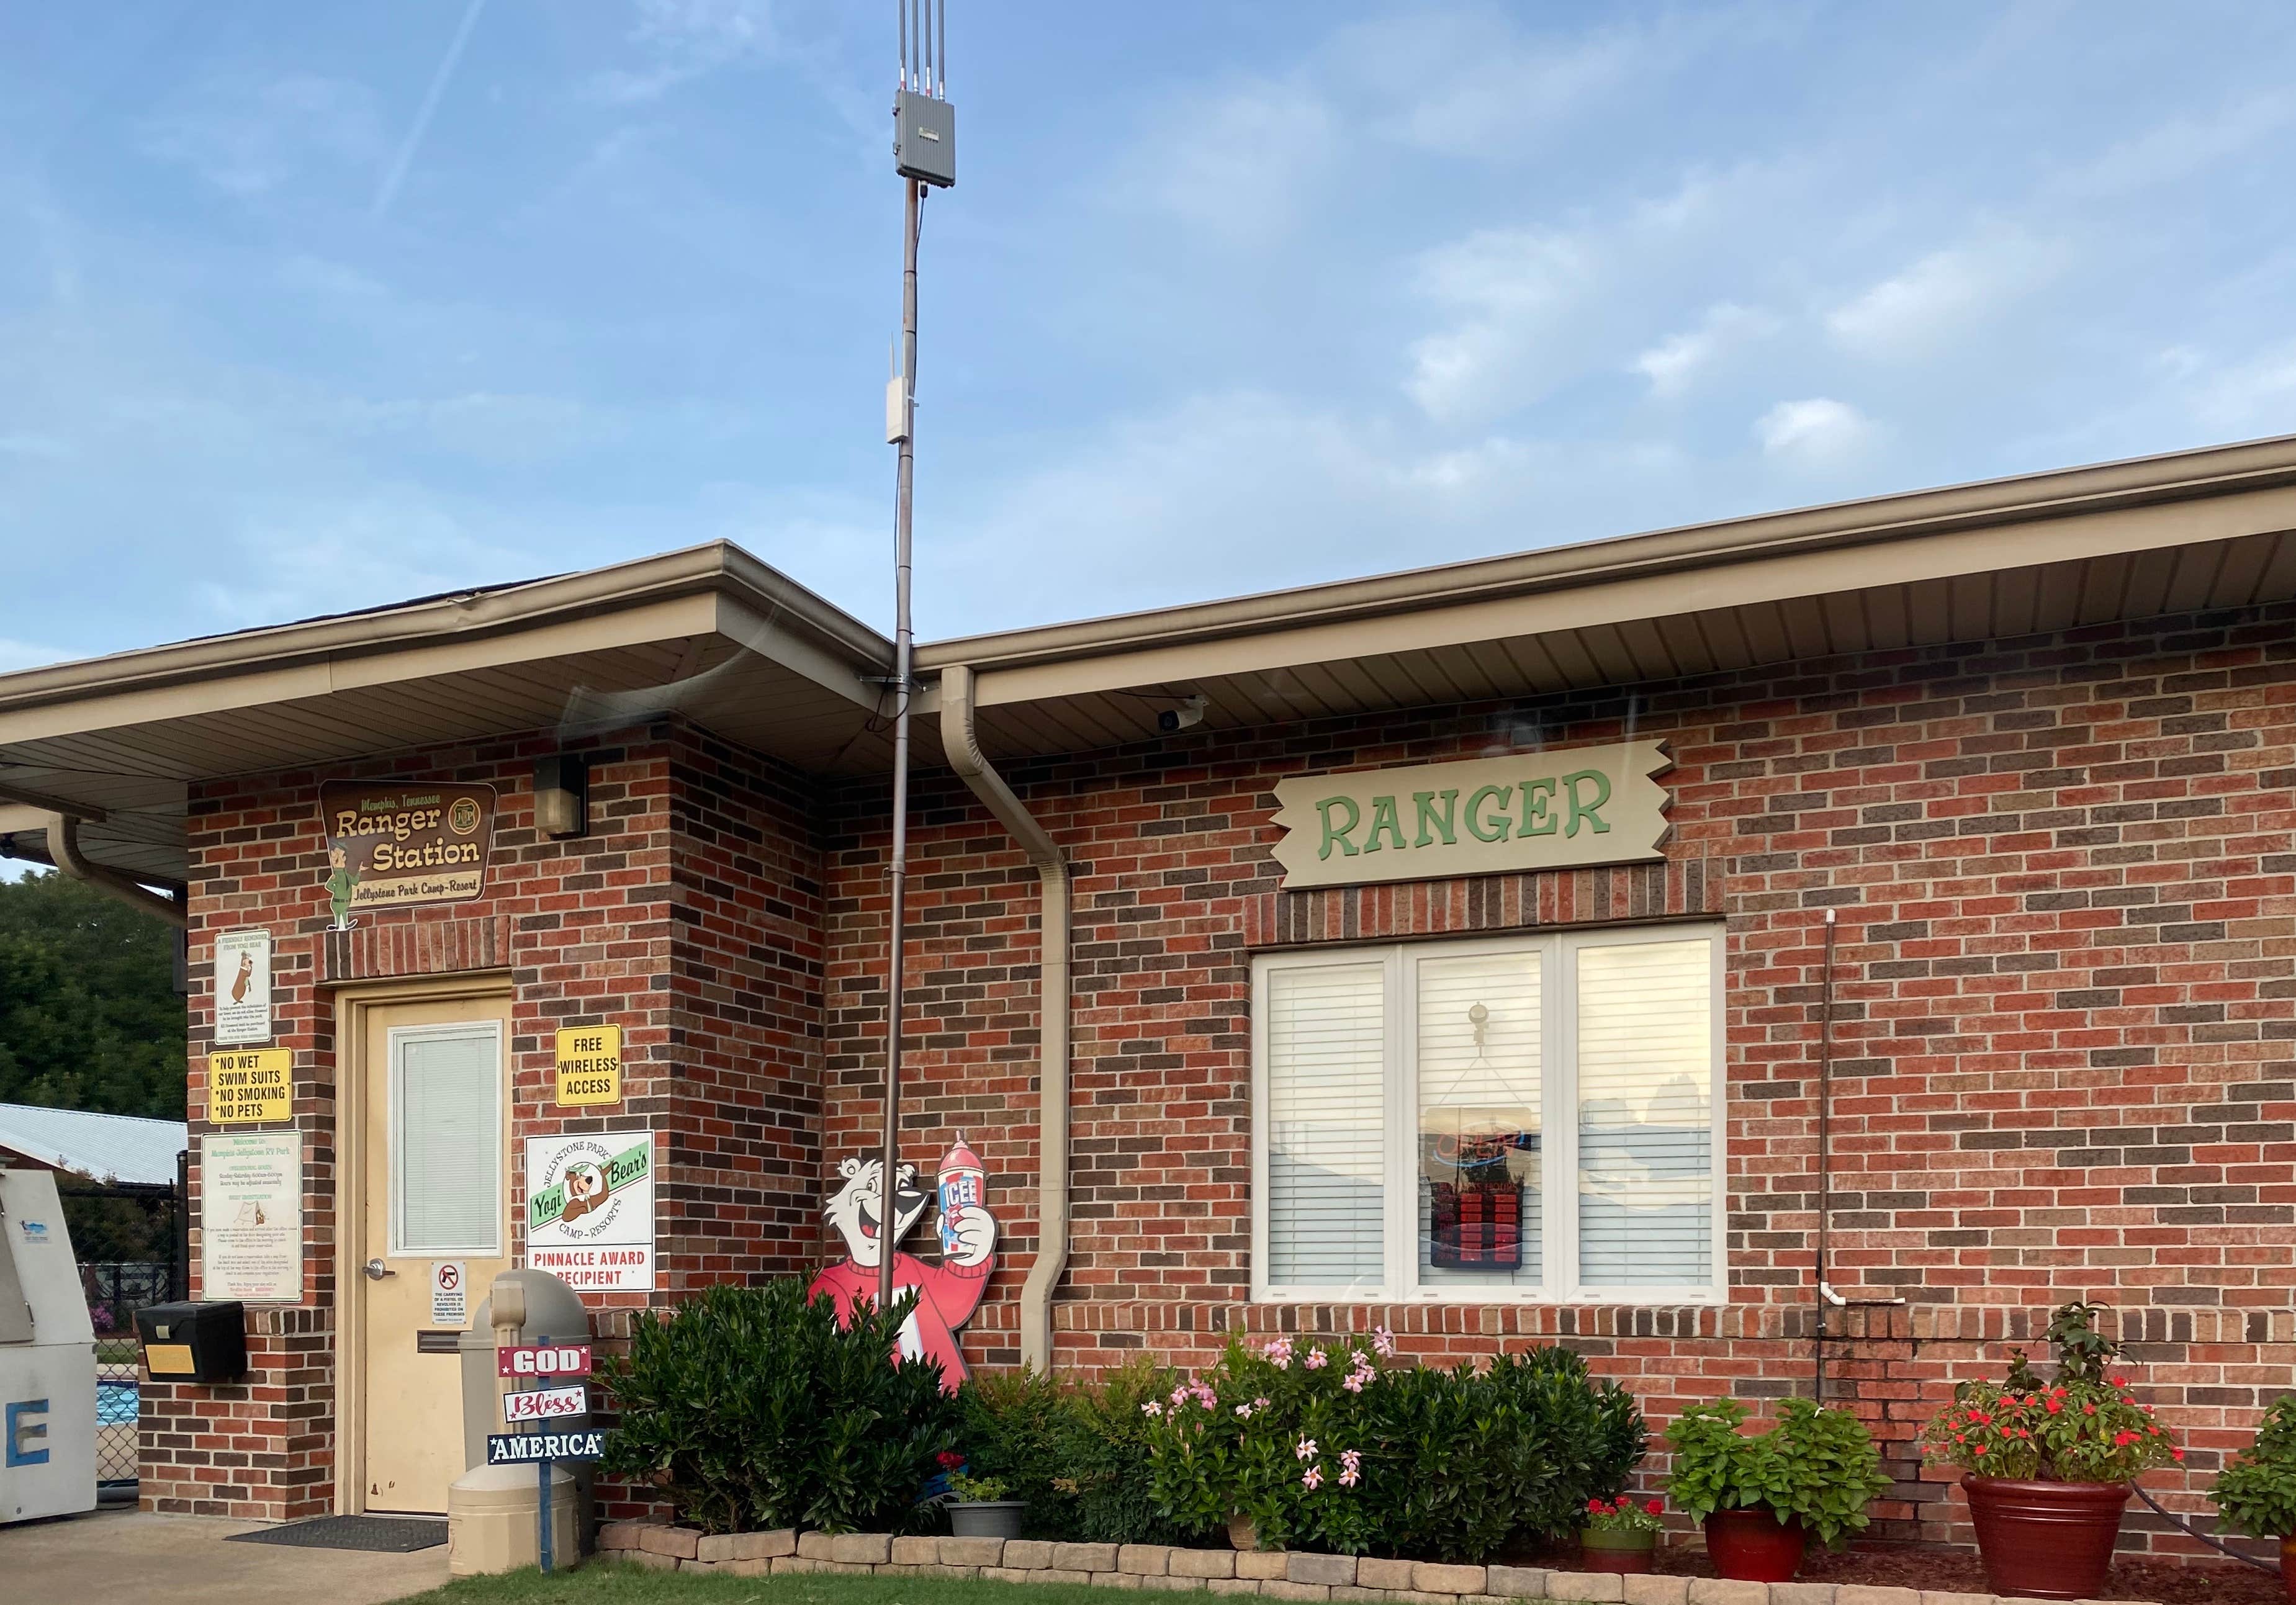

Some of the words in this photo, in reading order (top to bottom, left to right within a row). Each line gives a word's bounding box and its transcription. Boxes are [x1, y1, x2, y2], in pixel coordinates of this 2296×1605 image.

[361, 796, 398, 812] Memphis,
[402, 794, 441, 807] Tennessee
[1315, 769, 1611, 861] RANGER
[336, 809, 441, 842] Ranger
[373, 837, 480, 871] Station
[354, 886, 395, 902] Jellystone
[397, 883, 418, 896] Park
[421, 879, 477, 896] Camp-Resort
[574, 1037, 602, 1052] FREE
[220, 1056, 233, 1069] NO
[238, 1055, 259, 1069] WET
[560, 1057, 616, 1074] WIRELESS
[218, 1072, 247, 1086] SWIM
[251, 1070, 280, 1084] SUITS
[566, 1079, 610, 1095] ACCESS
[220, 1089, 233, 1102] NO
[238, 1086, 285, 1101] SMOKING
[220, 1105, 233, 1118] NO
[238, 1103, 263, 1117] PETS
[266, 1148, 274, 1156] RV
[276, 1146, 290, 1154] Park
[544, 1141, 585, 1187] JELLYSTONE
[586, 1142, 609, 1160] PARK
[534, 1189, 562, 1217] Yogi
[611, 1150, 647, 1185] Bear's
[944, 1180, 977, 1208] ICEE
[534, 1252, 594, 1267] PINNACLE
[600, 1251, 644, 1266] AWARD
[513, 1349, 580, 1373] GOD
[515, 1393, 579, 1416] Bless
[493, 1433, 600, 1460] AMERICA
